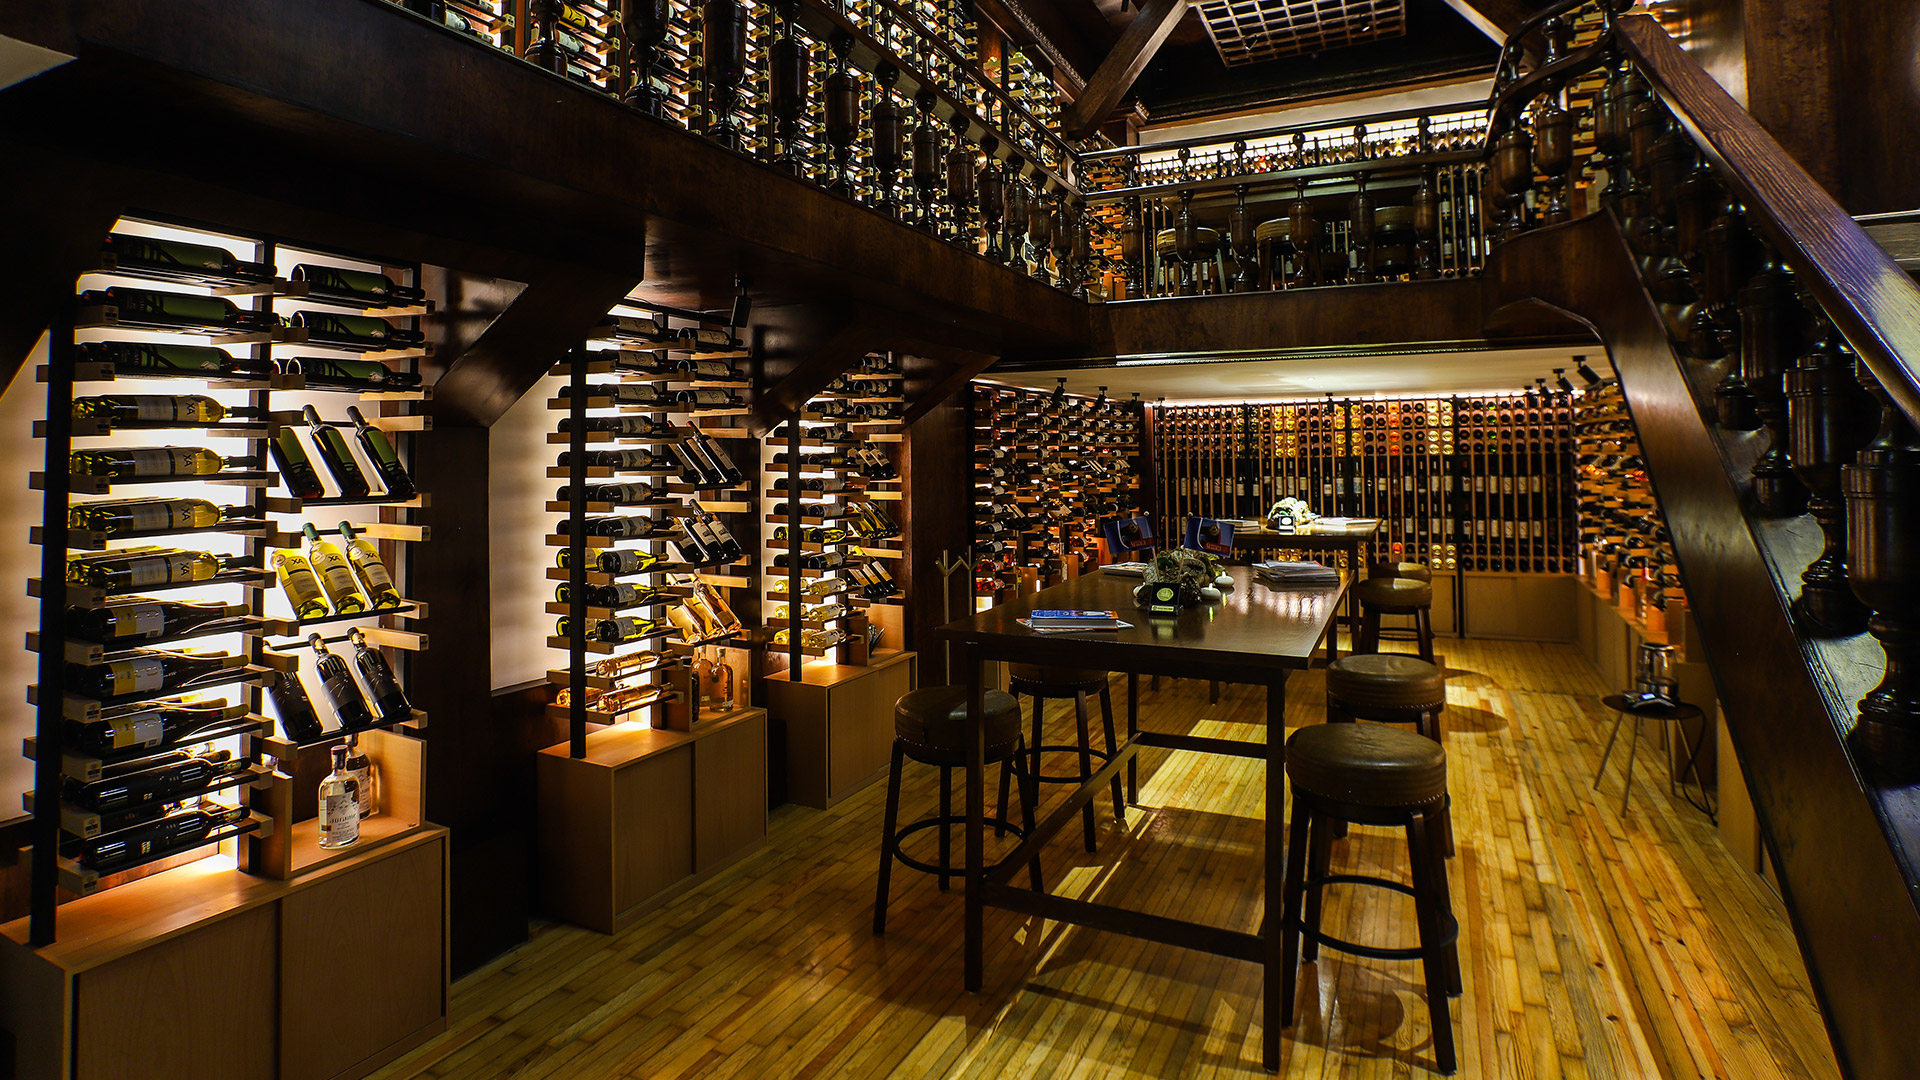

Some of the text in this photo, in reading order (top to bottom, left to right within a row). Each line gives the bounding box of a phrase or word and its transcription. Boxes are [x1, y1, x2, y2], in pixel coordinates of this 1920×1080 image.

[185, 402, 196, 416] XA
[183, 454, 193, 467] XA
[181, 508, 191, 522] XA
[180, 562, 190, 576] XA
